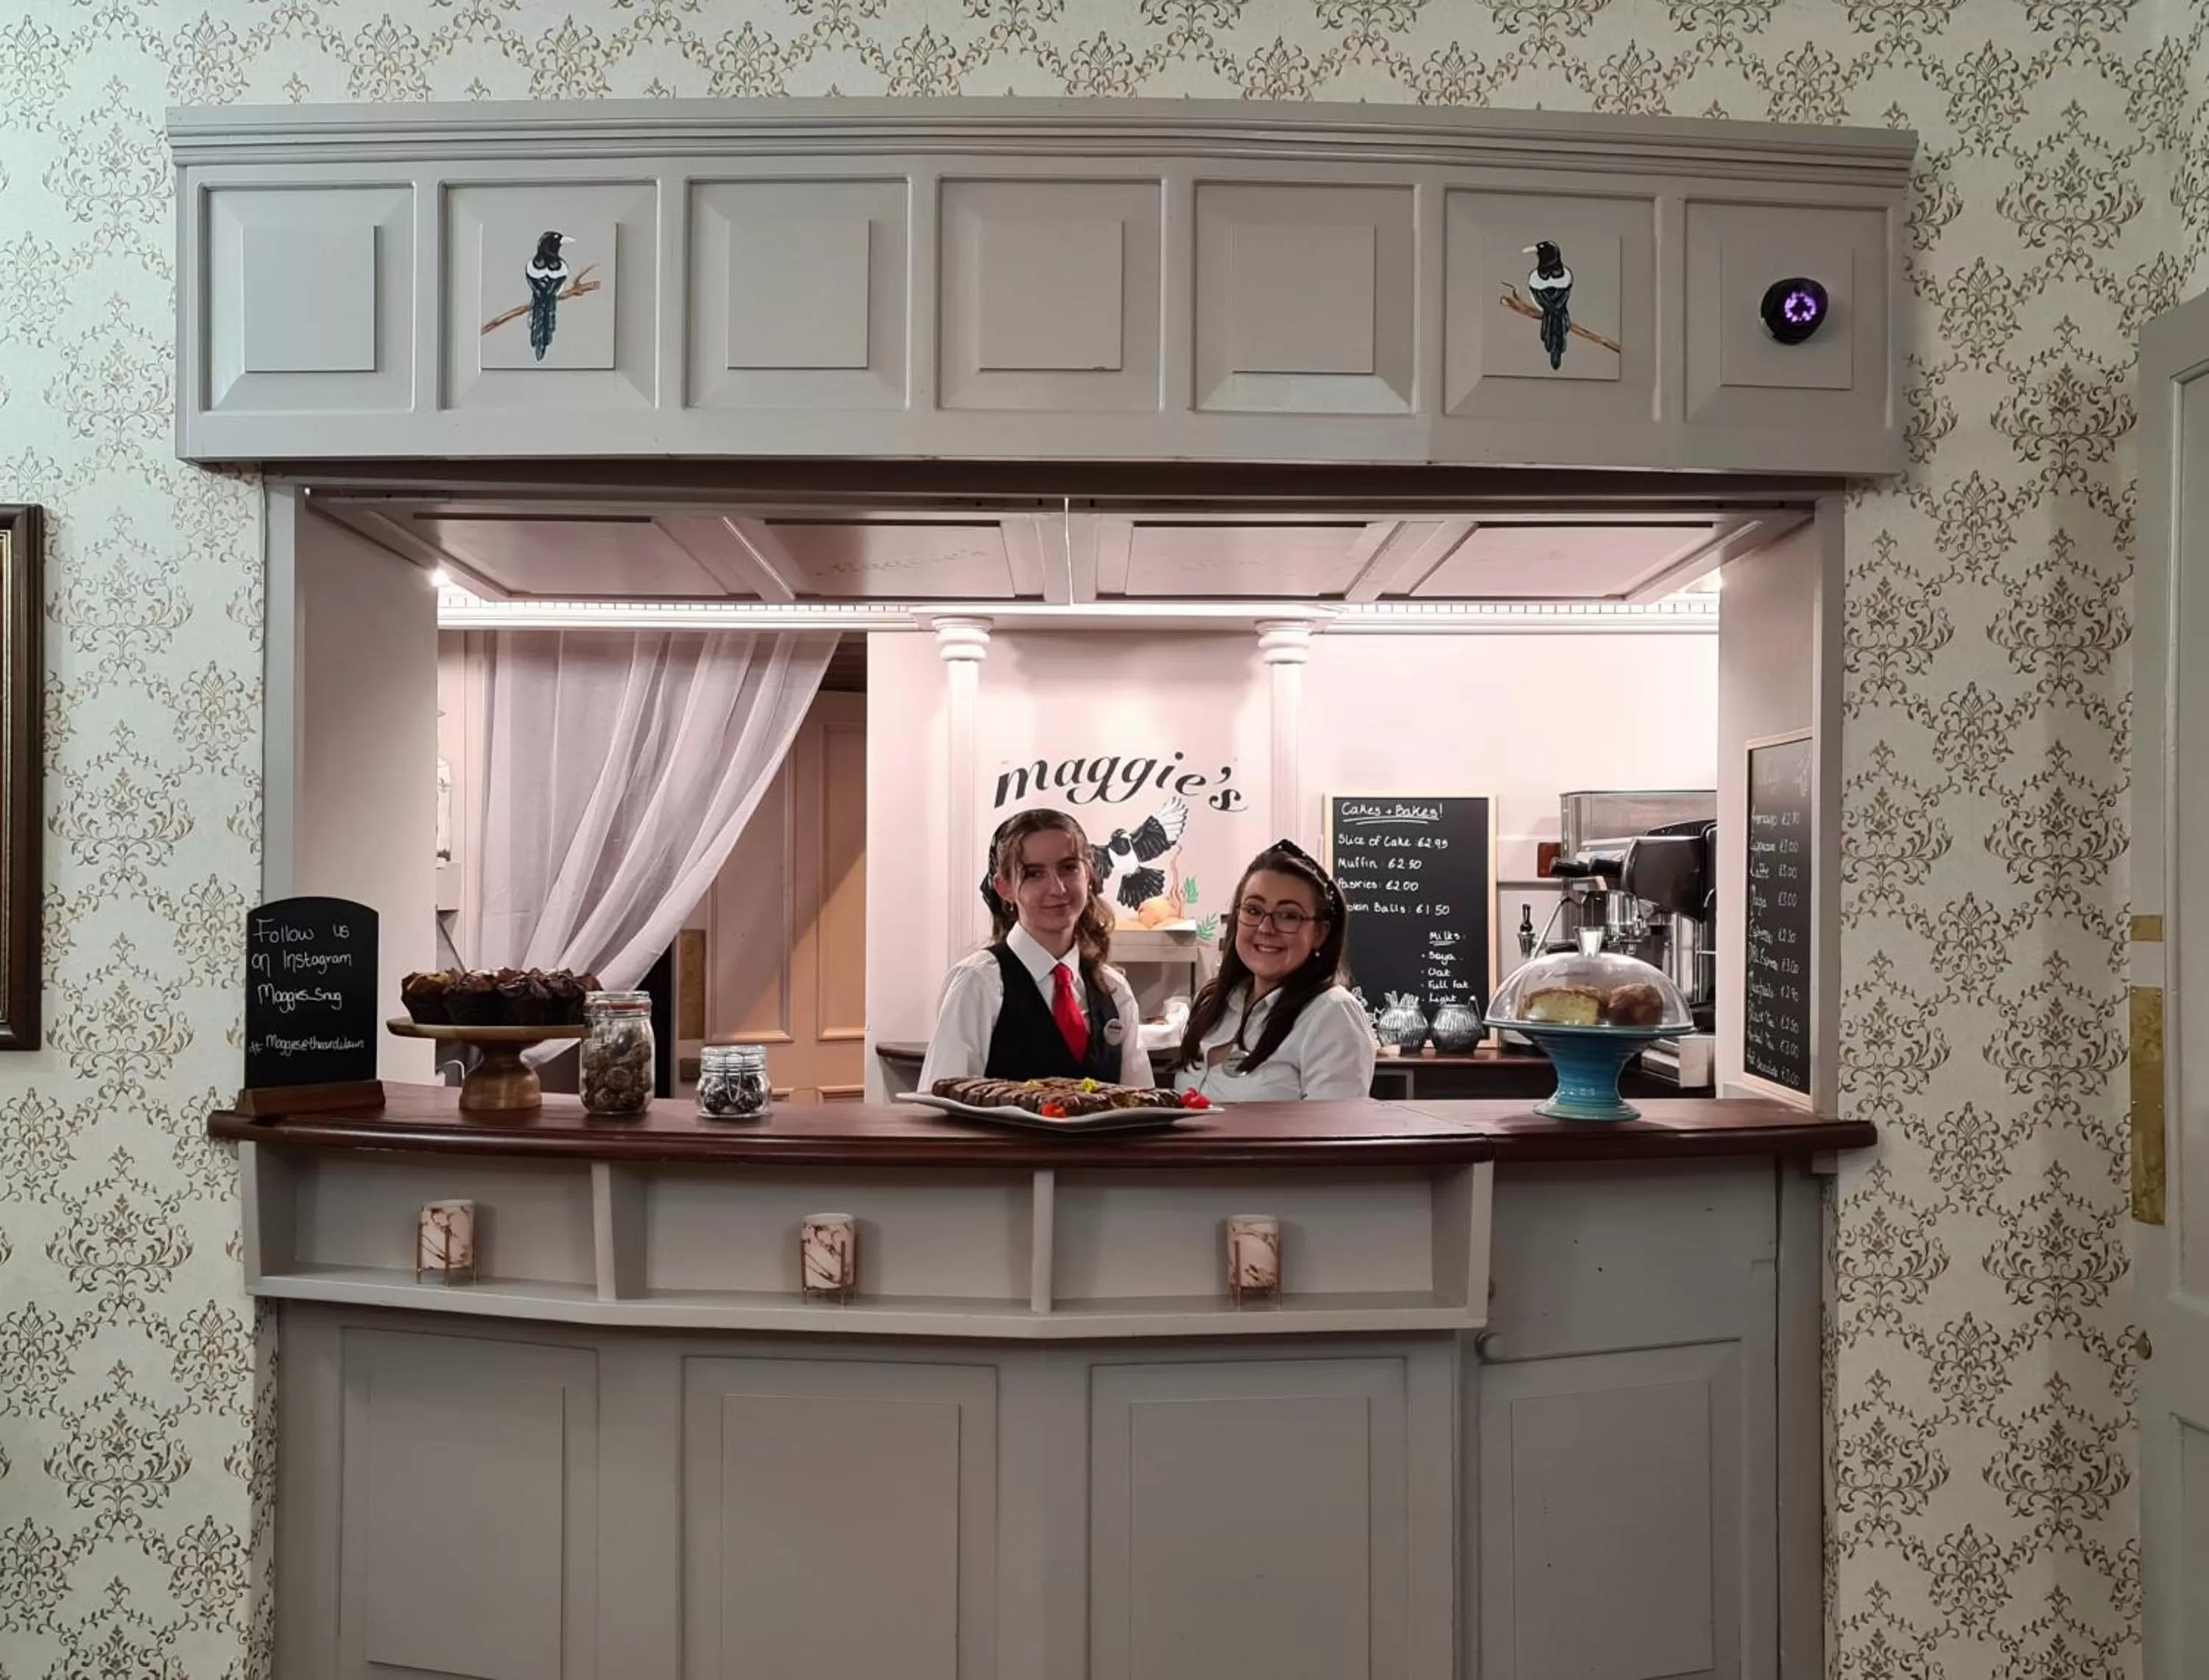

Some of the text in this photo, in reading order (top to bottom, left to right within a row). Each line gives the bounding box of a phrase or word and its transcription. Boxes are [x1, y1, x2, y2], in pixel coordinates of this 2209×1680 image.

[993, 751, 1248, 812] maggie's
[1341, 802, 1381, 816] Cakes
[1395, 802, 1443, 819] Bakes!
[1338, 833, 1366, 846] Slice
[1369, 834, 1382, 847] of
[1384, 835, 1412, 848] Cake
[1337, 856, 1378, 869] Muffin
[253, 918, 315, 943] Follow
[251, 949, 353, 978] on Instagram
[1428, 950, 1457, 965] Soya
[1428, 967, 1451, 977] Oat
[1428, 979, 1448, 989] Full
[1429, 992, 1457, 1005] Light
